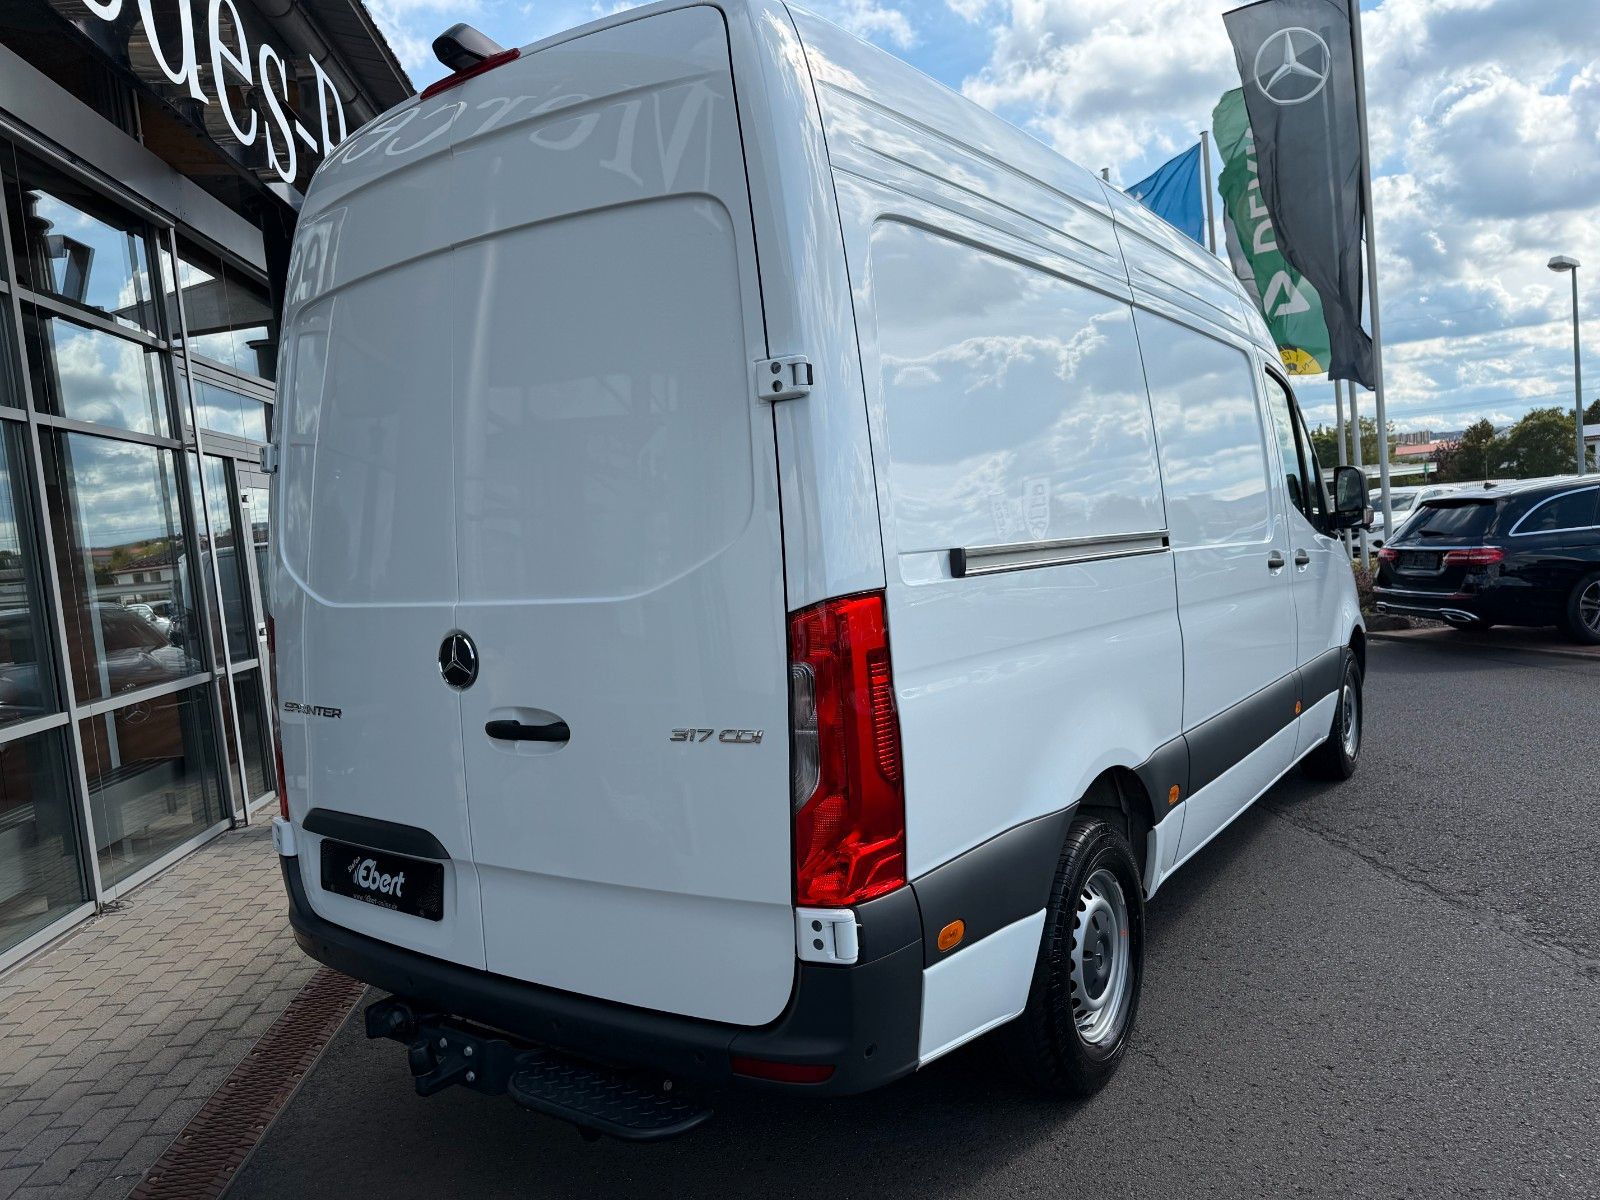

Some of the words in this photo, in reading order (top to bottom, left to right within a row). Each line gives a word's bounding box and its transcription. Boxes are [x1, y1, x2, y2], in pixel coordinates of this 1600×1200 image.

[284, 701, 343, 719] SPRINTER
[669, 728, 715, 742] 317
[719, 729, 764, 744] CDI
[357, 858, 406, 898] Ebert
